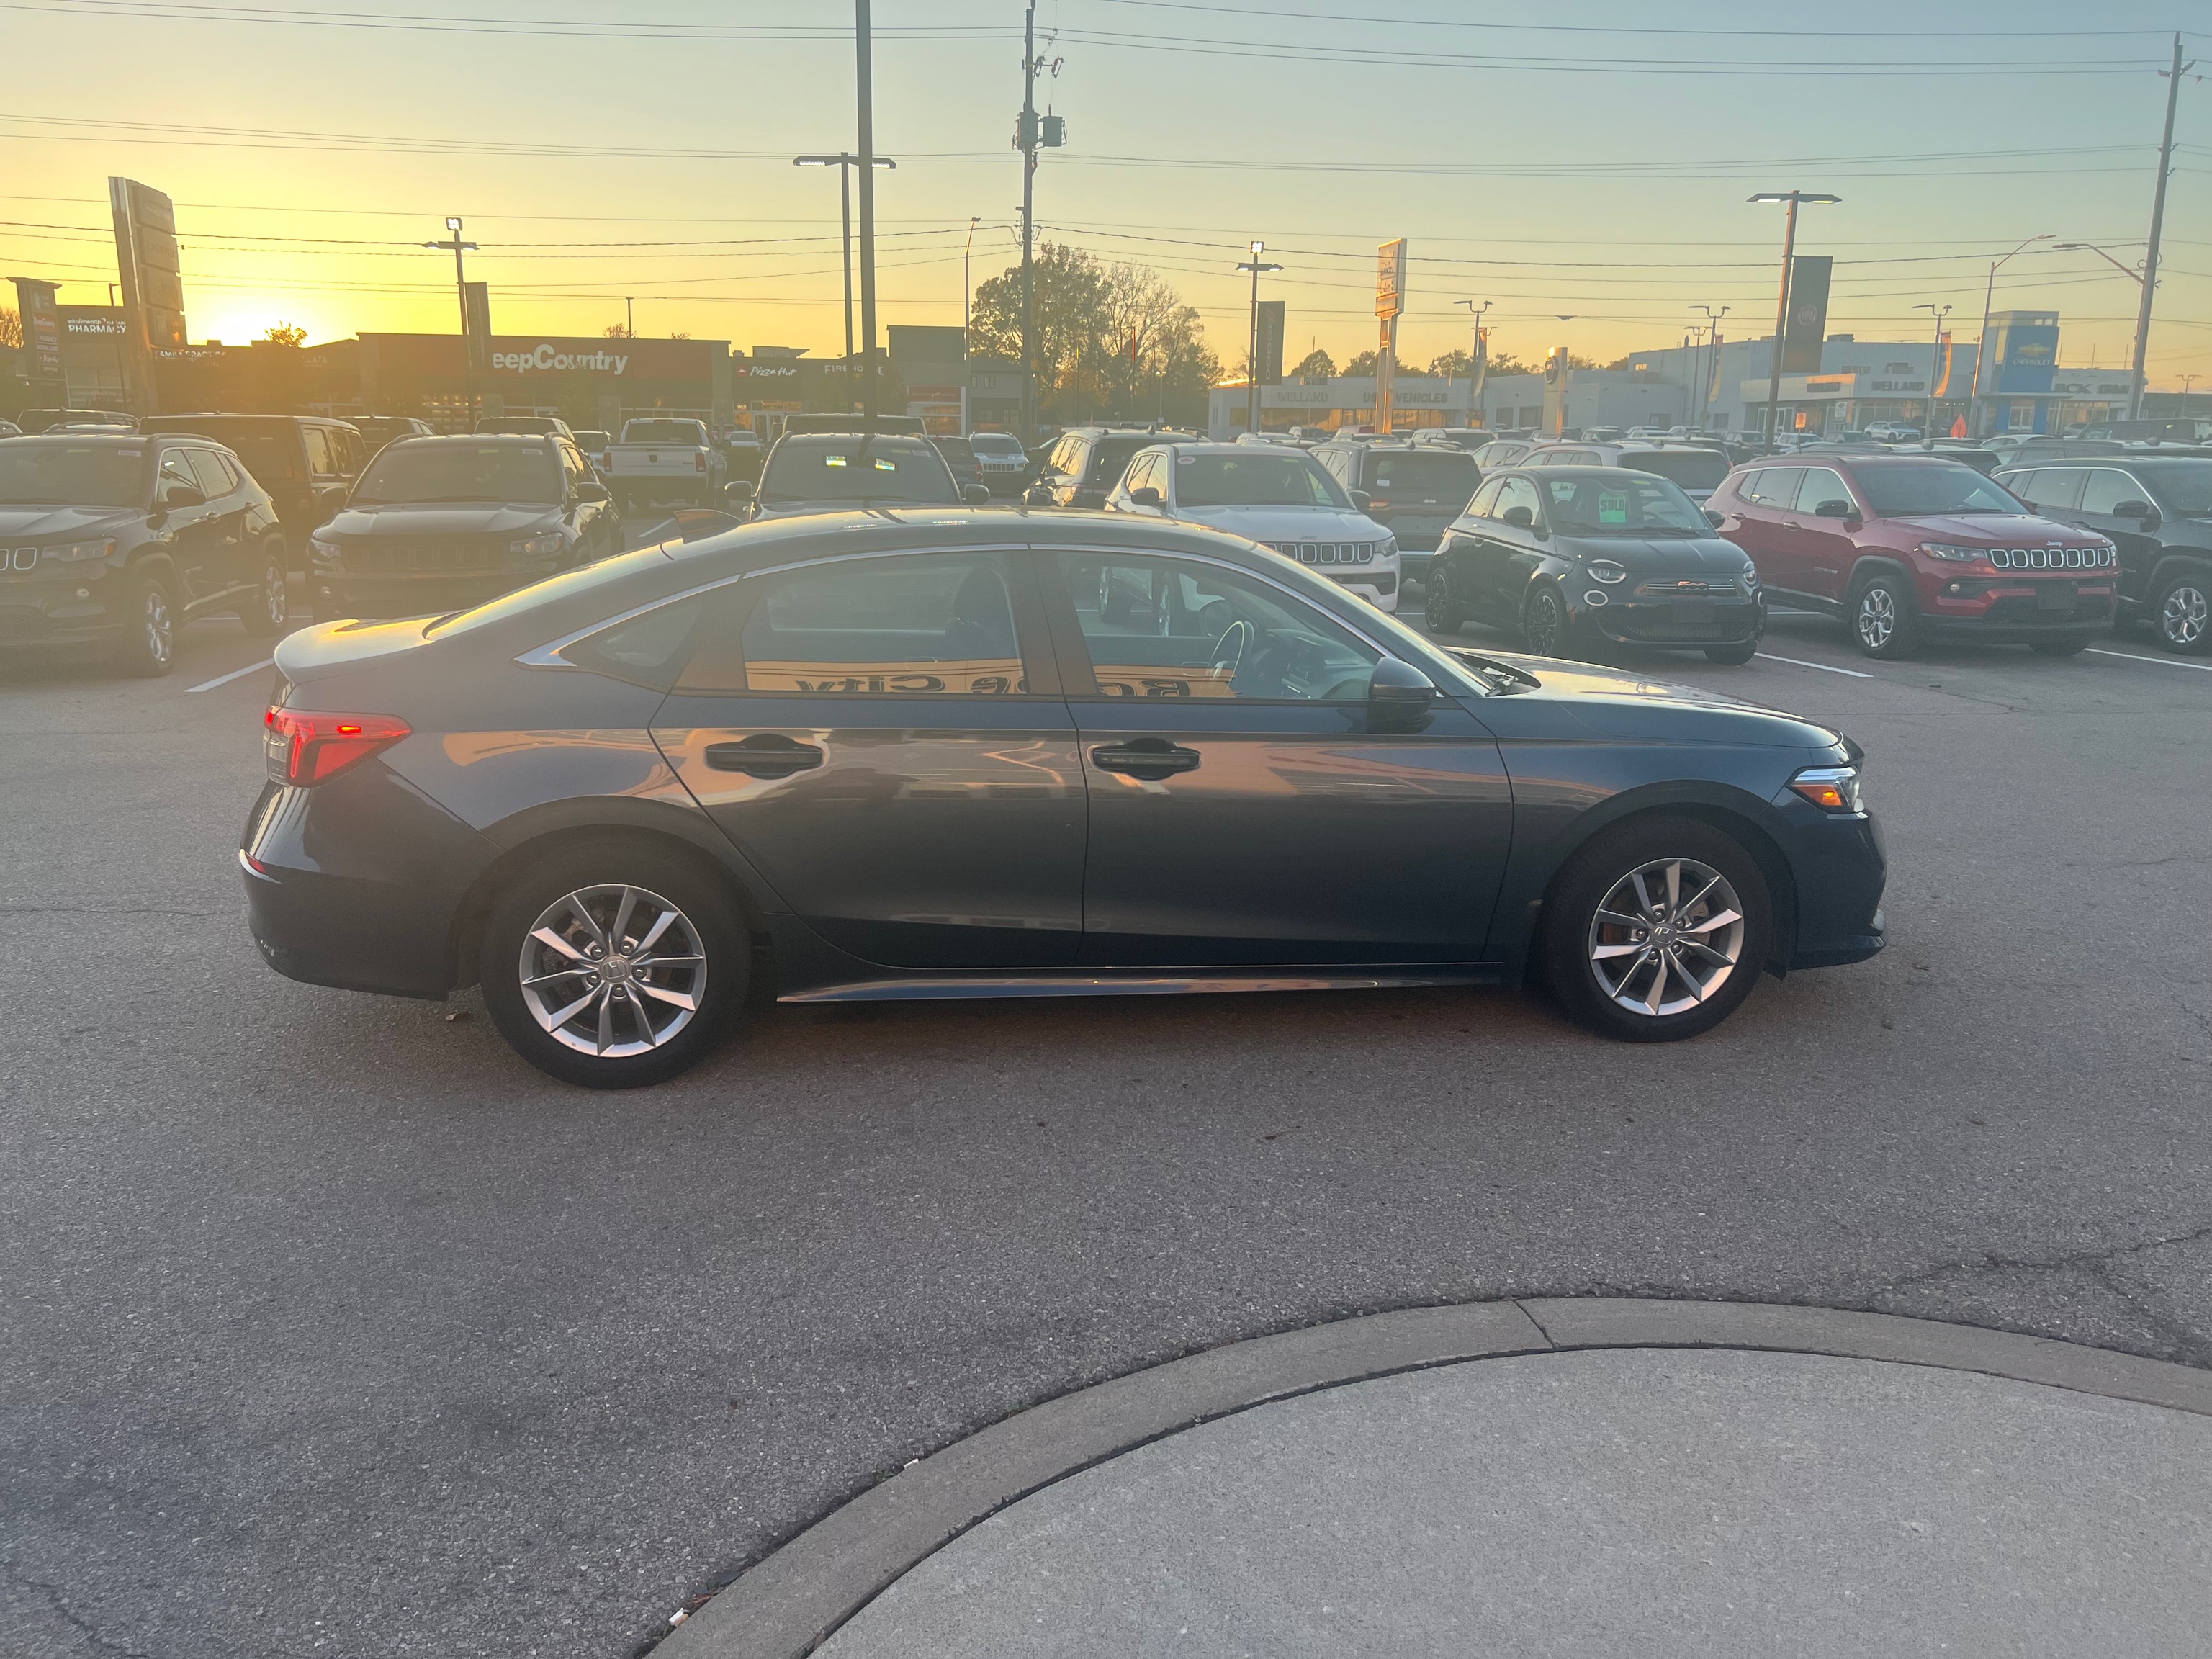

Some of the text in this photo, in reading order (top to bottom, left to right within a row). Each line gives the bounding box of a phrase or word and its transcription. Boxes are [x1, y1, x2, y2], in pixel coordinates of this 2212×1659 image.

[68, 324, 127, 333] PHARMACY
[492, 343, 628, 375] eepCountry
[750, 366, 797, 377] Pizza Hut
[1871, 380, 1925, 392] WELLAND
[1277, 391, 1328, 403] WELLAND
[1395, 392, 1448, 403] VEHICLES
[1600, 499, 1624, 512] SOLD
